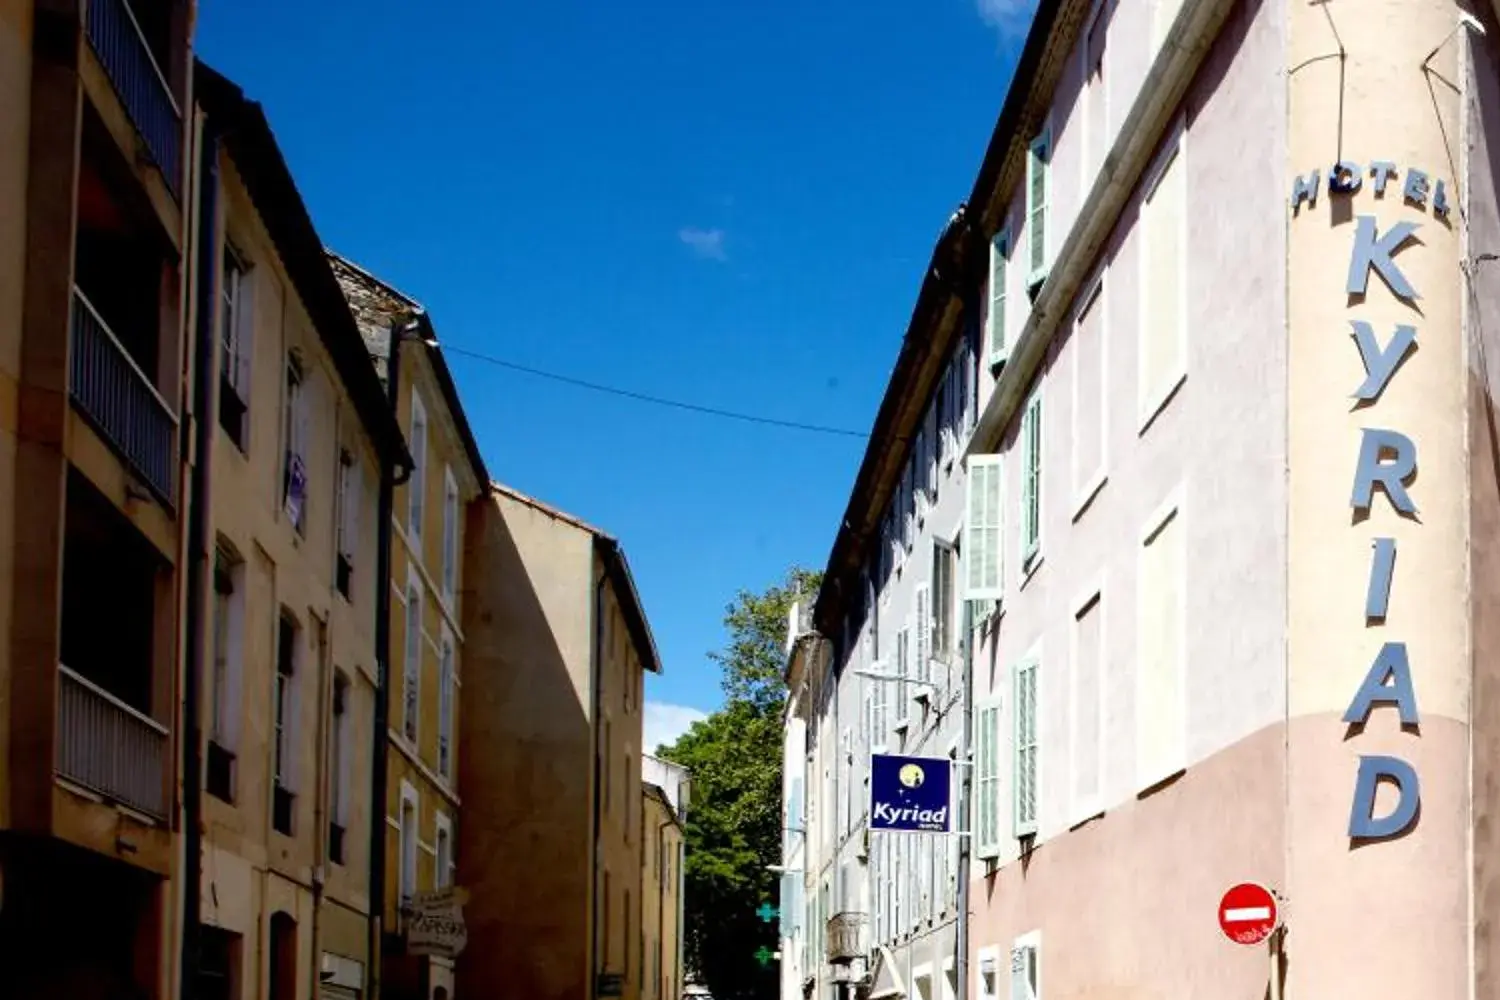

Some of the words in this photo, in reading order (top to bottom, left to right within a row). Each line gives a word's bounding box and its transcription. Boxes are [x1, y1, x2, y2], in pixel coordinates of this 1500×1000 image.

[1291, 160, 1451, 218] HOTEL
[1342, 215, 1422, 839] KYRIAD
[873, 802, 947, 825] Kyriad
